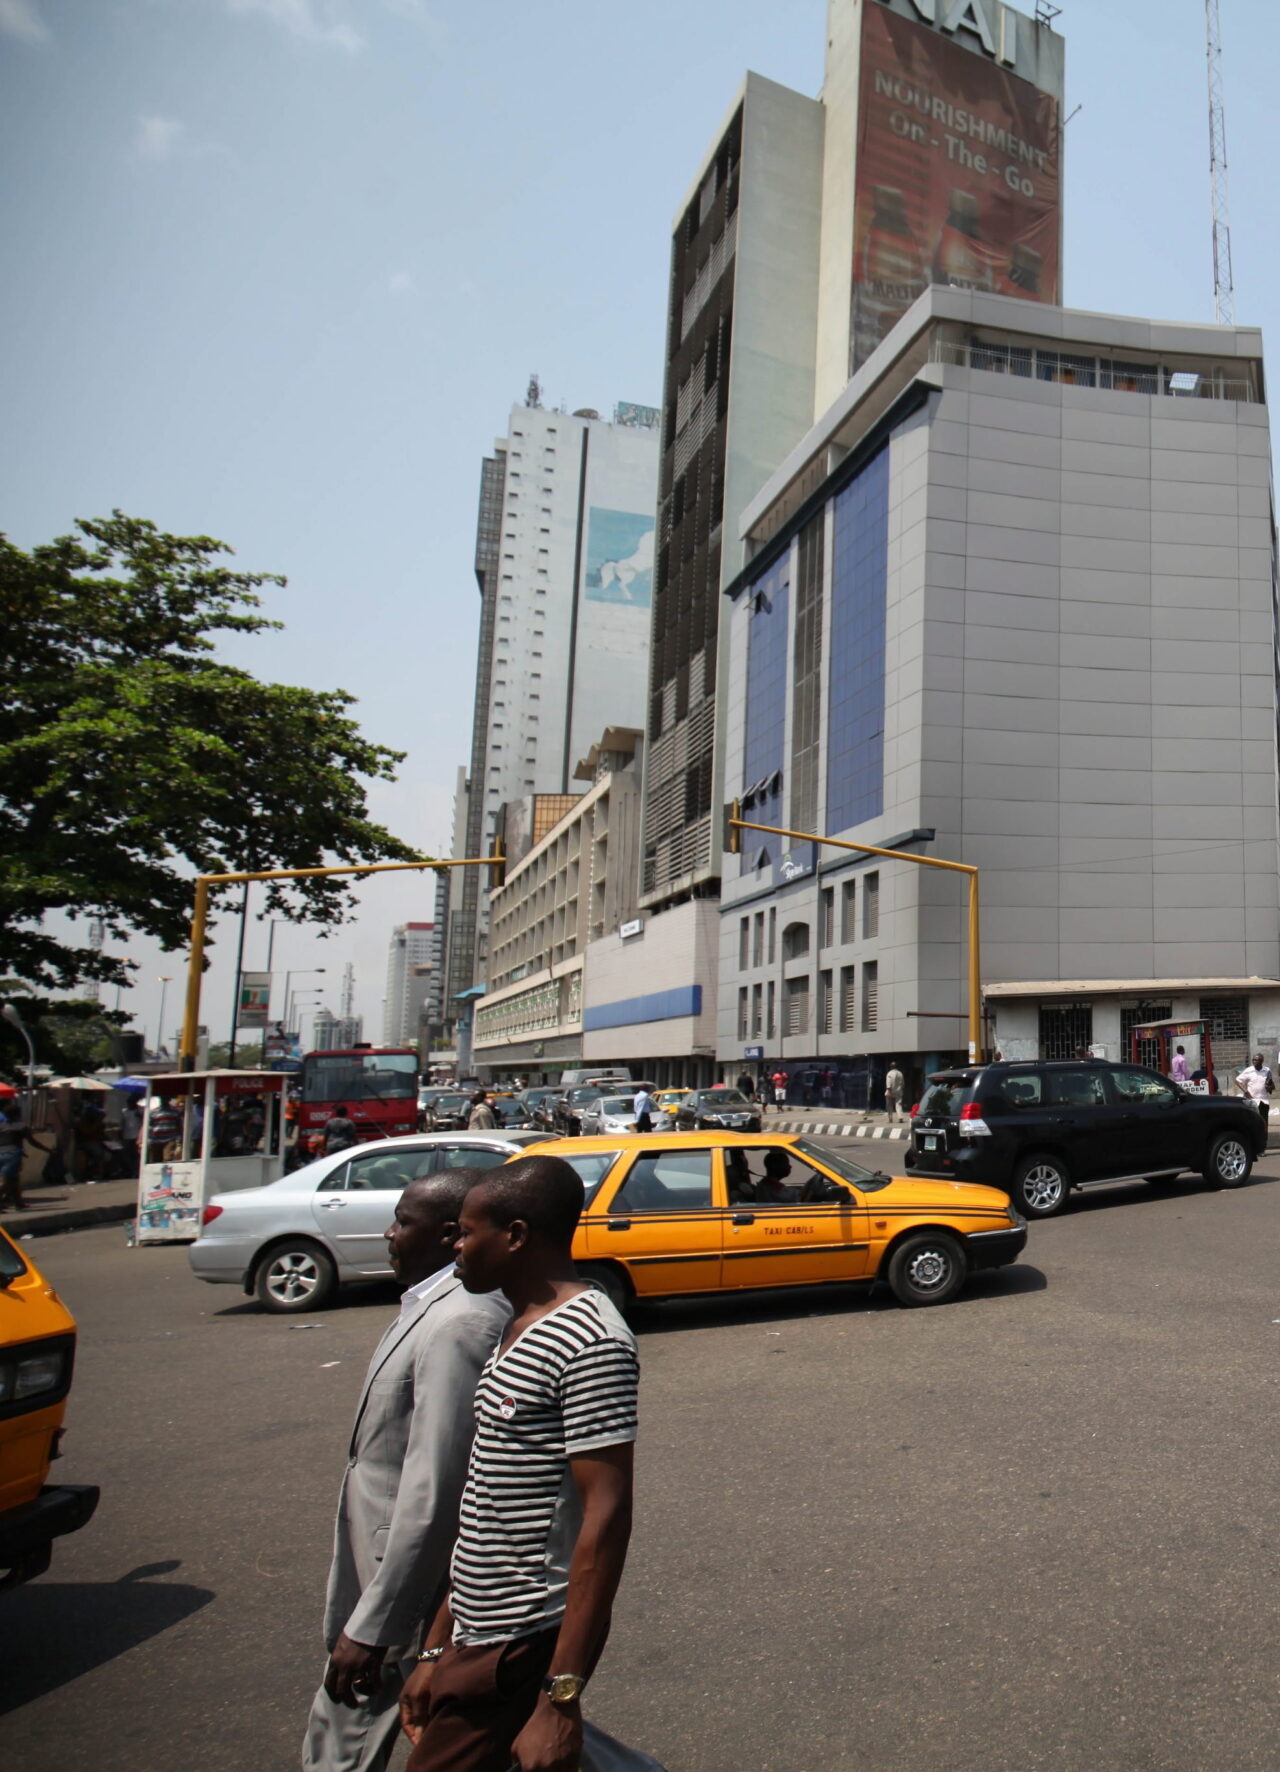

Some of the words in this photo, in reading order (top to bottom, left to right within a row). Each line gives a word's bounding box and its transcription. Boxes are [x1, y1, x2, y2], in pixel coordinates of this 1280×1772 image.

[875, 70, 1047, 171] NOURISHMENT
[944, 133, 987, 174] The
[1005, 166, 1034, 197] Go
[232, 1078, 264, 1089] POLICE
[764, 1227, 783, 1235] TAXI
